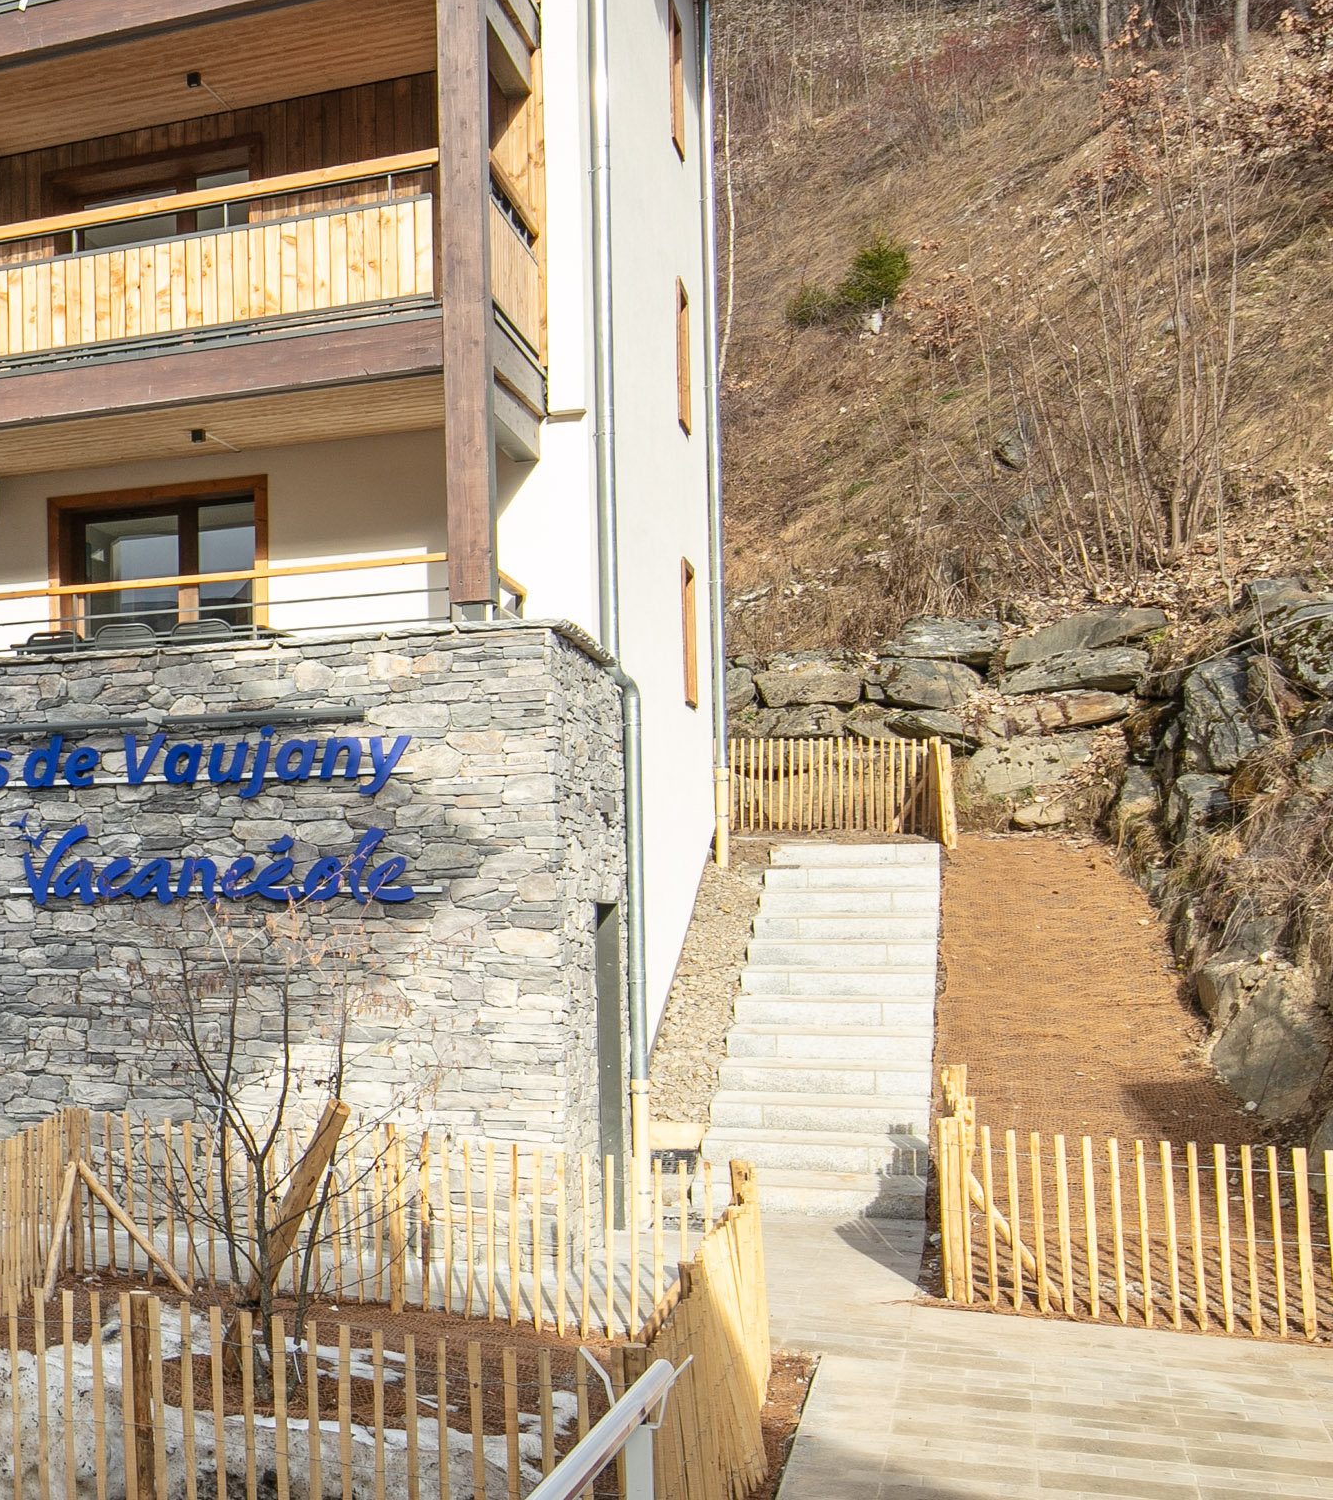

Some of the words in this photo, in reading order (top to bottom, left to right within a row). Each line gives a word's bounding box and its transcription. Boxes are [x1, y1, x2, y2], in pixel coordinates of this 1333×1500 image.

[23, 734, 100, 788] de
[124, 725, 413, 799] Vaujany
[22, 824, 415, 904] Vacancéole
